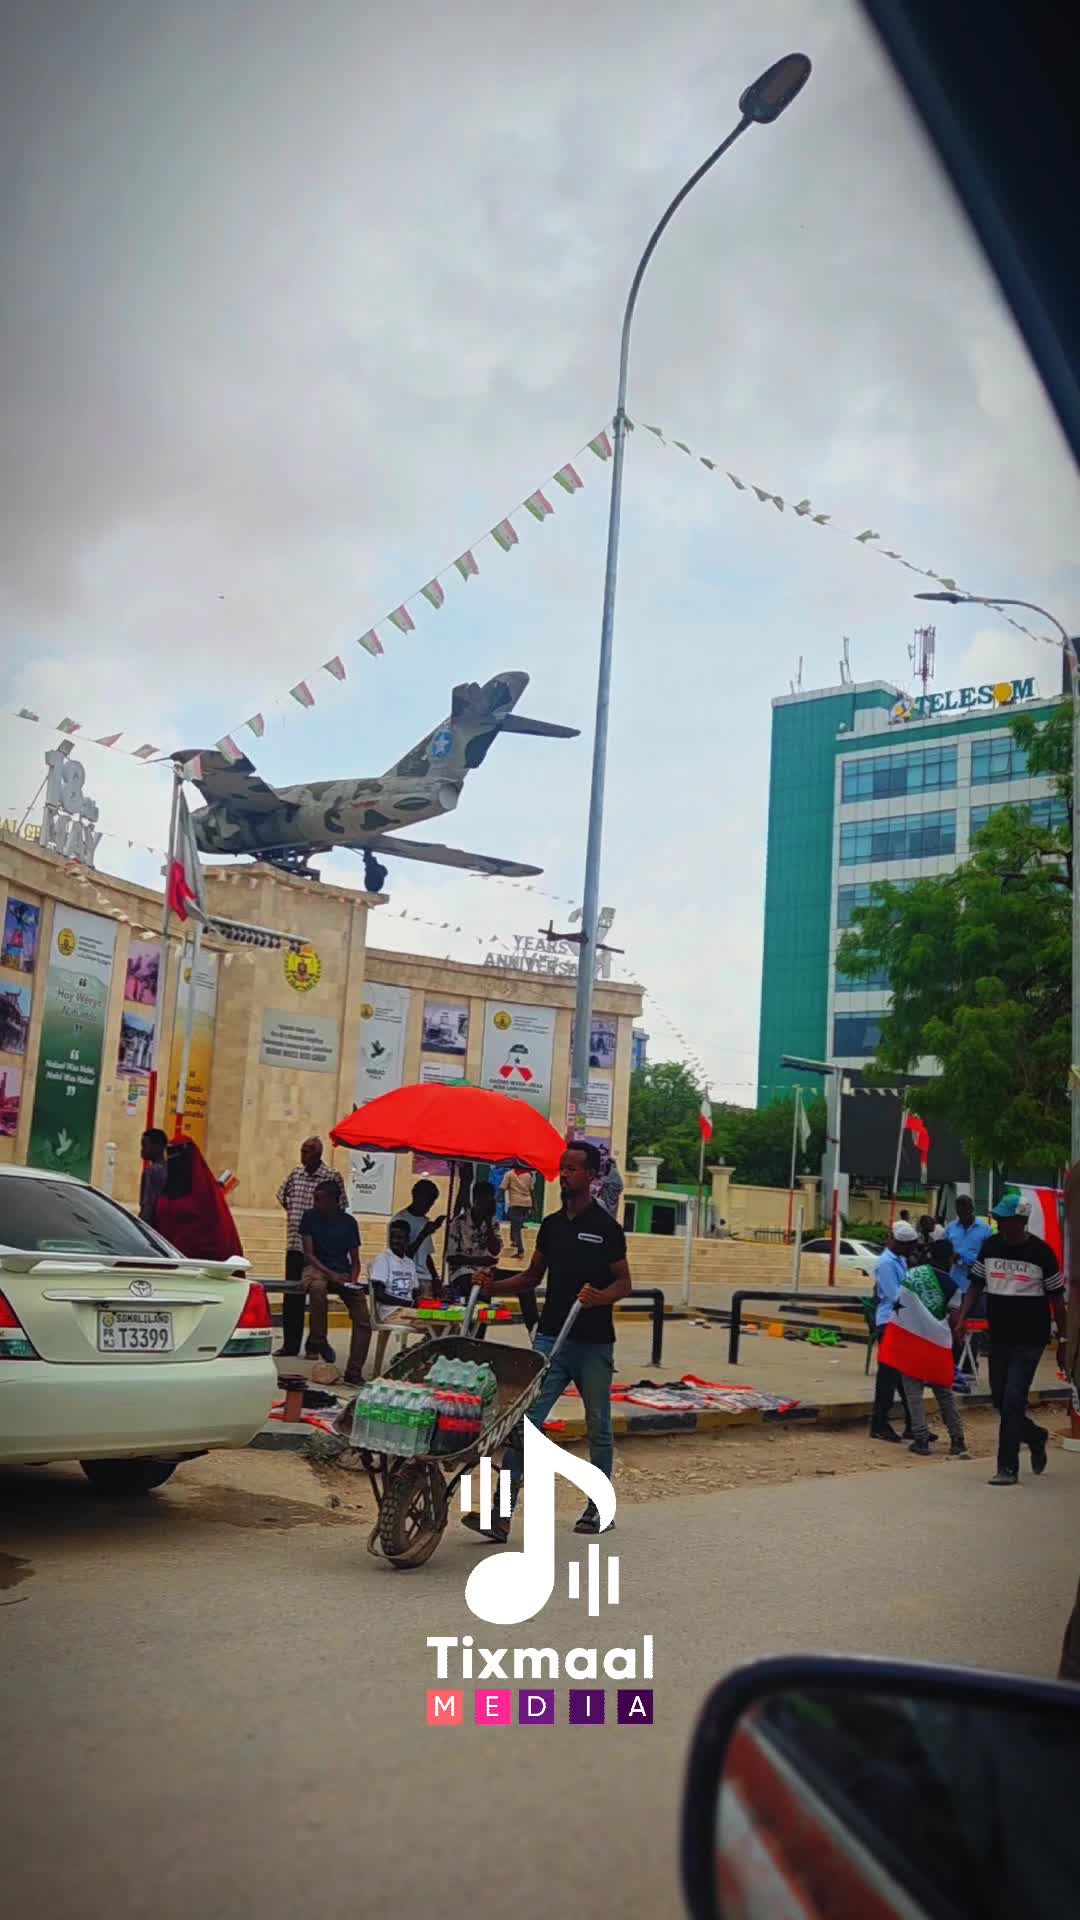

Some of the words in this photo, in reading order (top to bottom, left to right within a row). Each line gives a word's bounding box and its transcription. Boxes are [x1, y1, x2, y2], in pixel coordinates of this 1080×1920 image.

[914, 677, 1036, 715] TELESOM
[512, 934, 569, 954] YEARS
[116, 1313, 169, 1324] SOMALILAND
[118, 1328, 169, 1349] T3399
